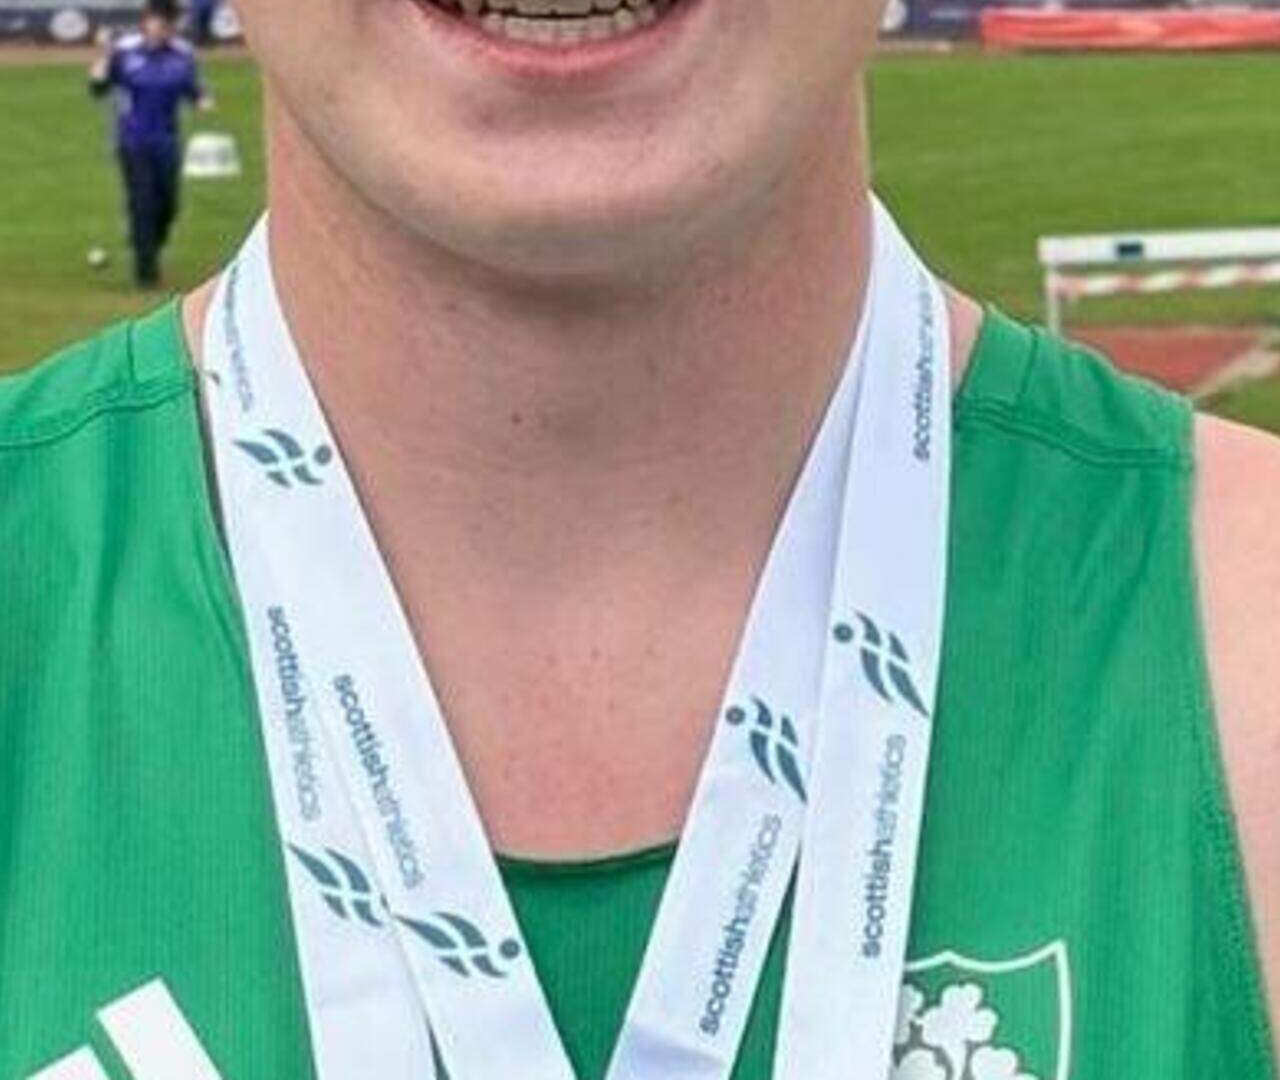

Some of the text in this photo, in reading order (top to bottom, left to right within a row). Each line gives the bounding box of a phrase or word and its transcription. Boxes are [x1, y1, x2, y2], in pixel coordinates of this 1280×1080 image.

[913, 291, 933, 460] scottisha
[268, 606, 319, 821] scottishathletics
[334, 674, 424, 889] scottishathletics
[700, 815, 781, 1036] scottishathletics
[861, 734, 907, 957] scottishathletics
